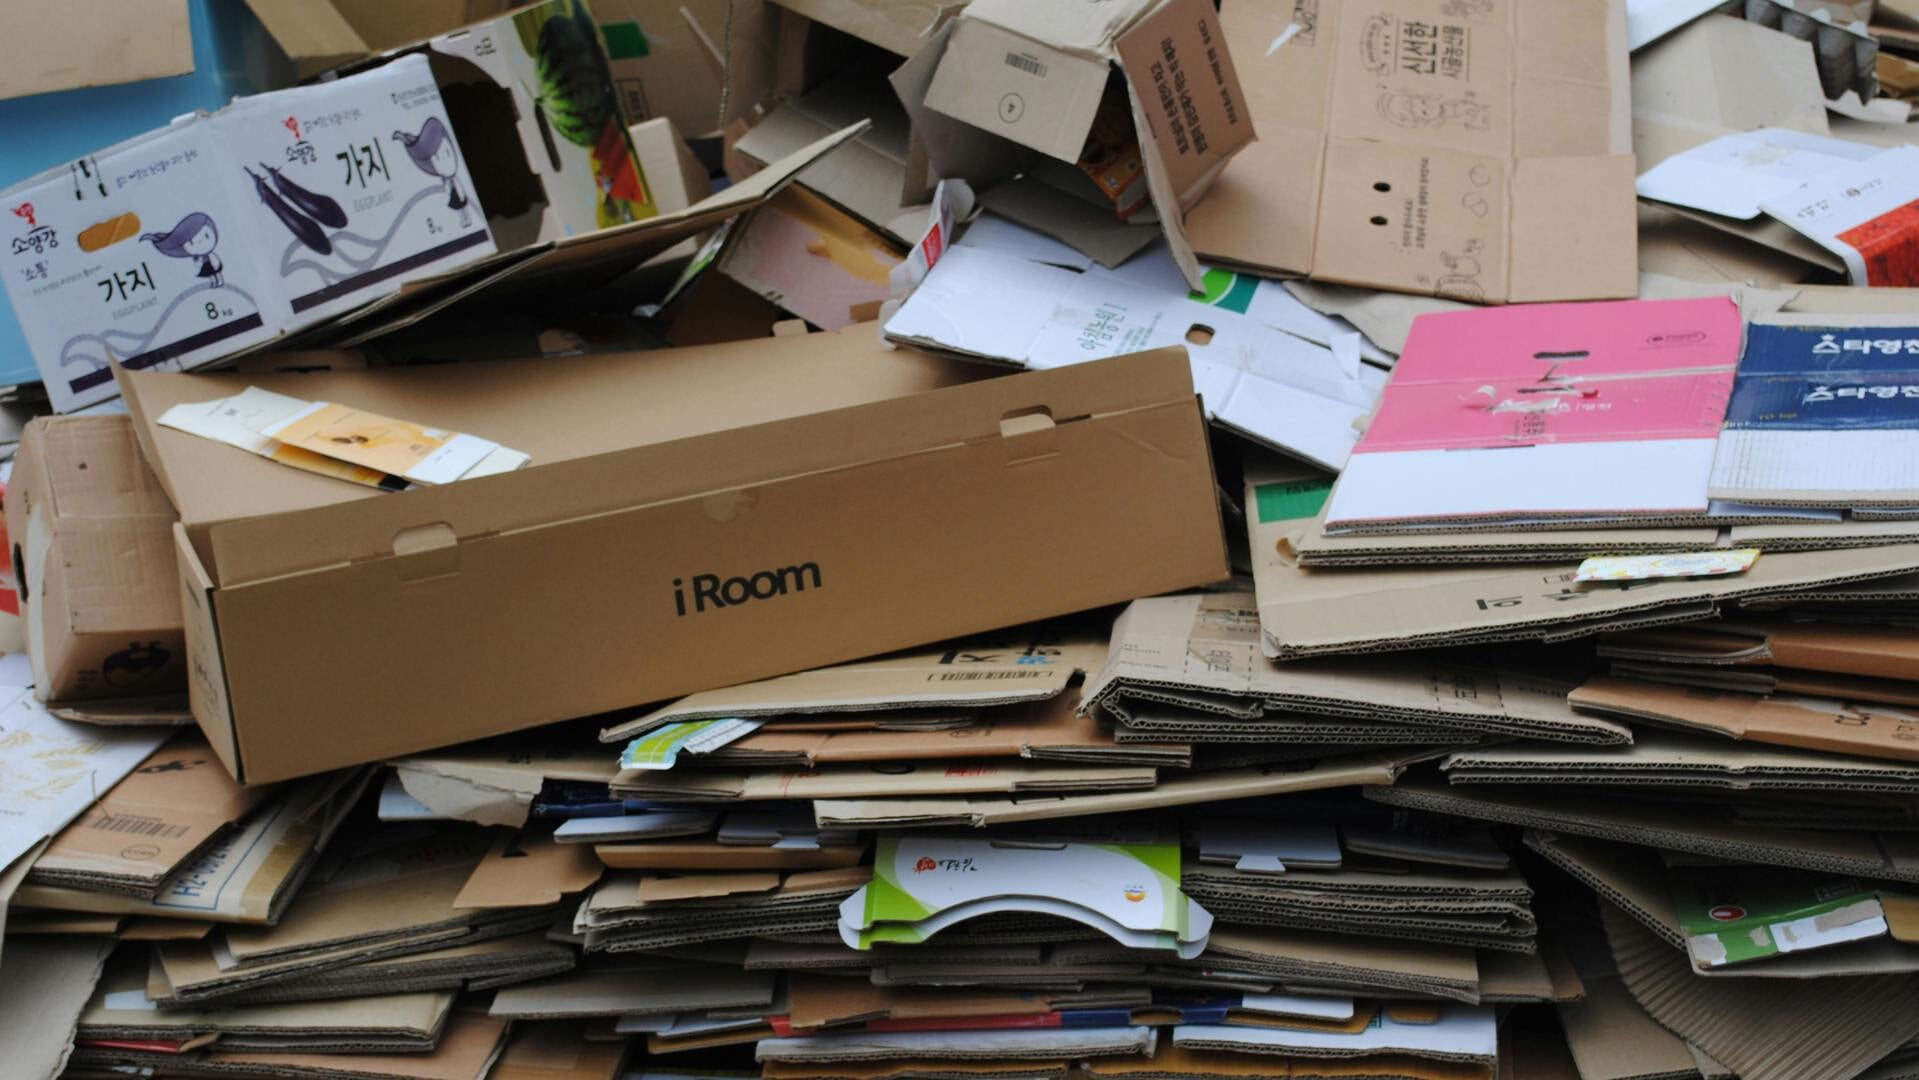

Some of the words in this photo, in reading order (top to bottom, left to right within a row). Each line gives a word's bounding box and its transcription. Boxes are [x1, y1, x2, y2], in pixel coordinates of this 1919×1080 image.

[1402, 20, 1438, 76] 신선한
[336, 136, 391, 190] 가지
[353, 190, 395, 213] EGGPLANT
[11, 227, 59, 256] 소양강
[97, 262, 157, 304] 가지
[112, 297, 159, 321] EGGPLANT
[205, 302, 219, 320] 8
[673, 578, 686, 616] i
[693, 561, 822, 612] Room
